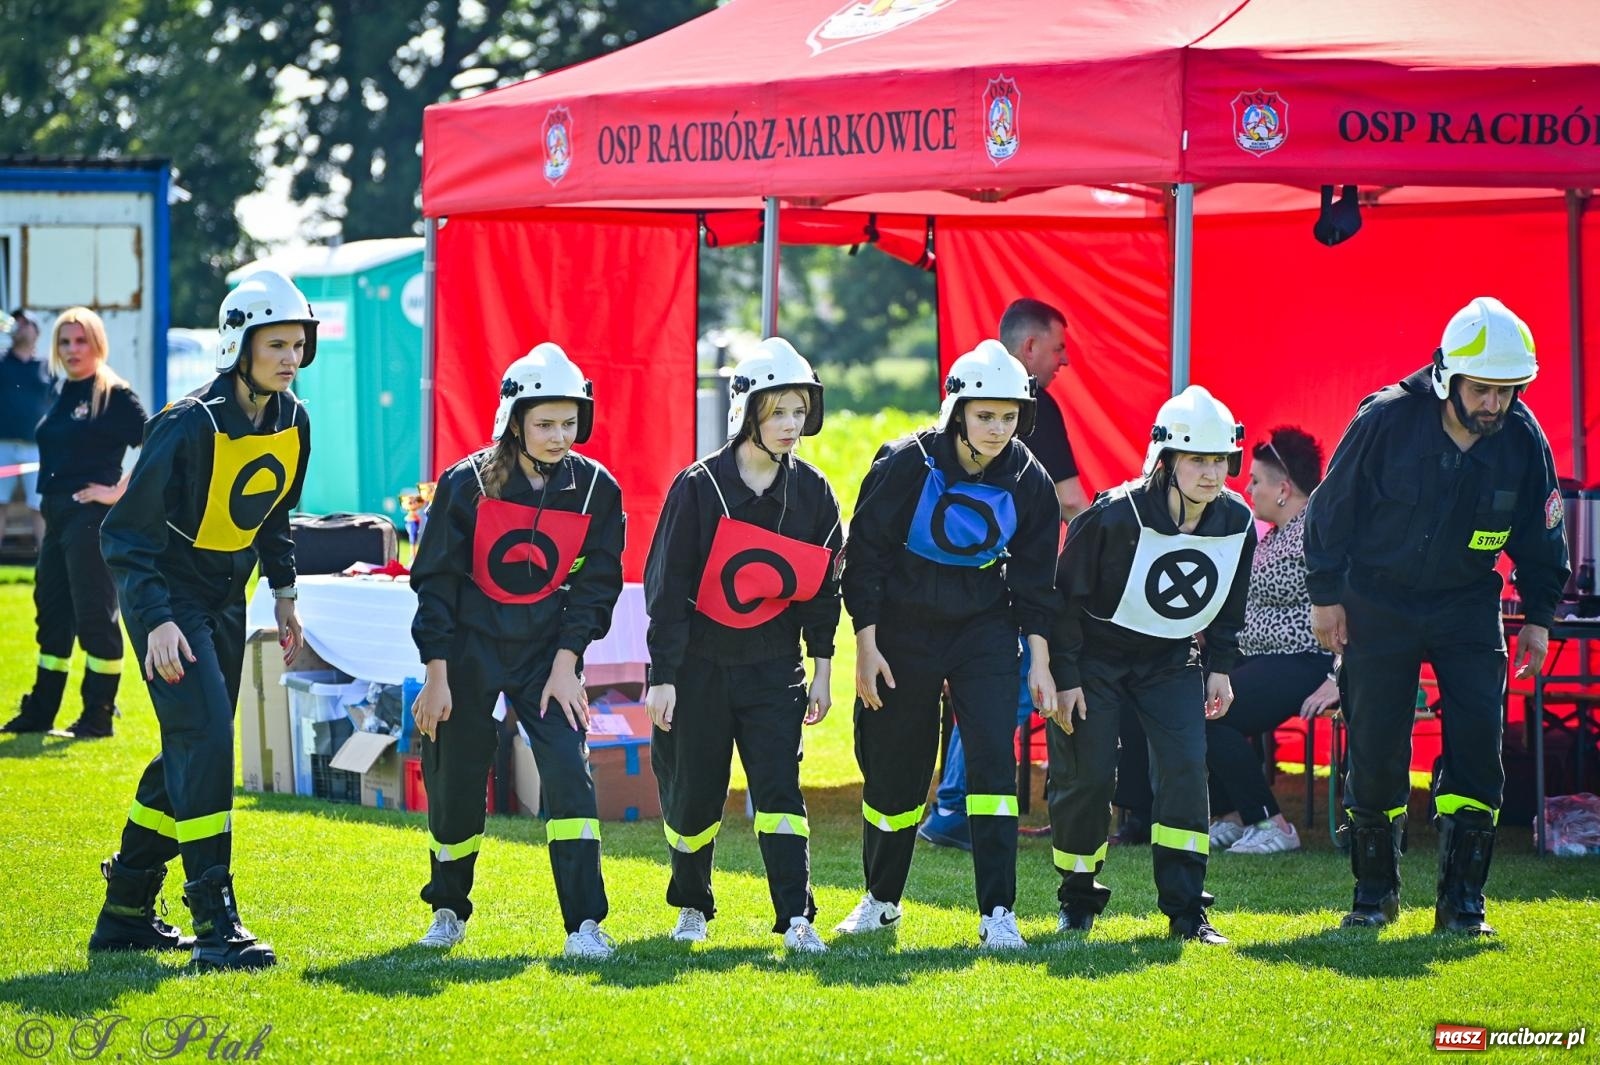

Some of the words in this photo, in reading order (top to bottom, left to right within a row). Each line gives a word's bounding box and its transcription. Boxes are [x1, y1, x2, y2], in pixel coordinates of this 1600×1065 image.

[1242, 93, 1276, 106] OSP
[598, 124, 641, 165] OSP
[646, 108, 957, 164] RACIBÓRZ-MARKOWICE
[1338, 110, 1416, 143] OSP
